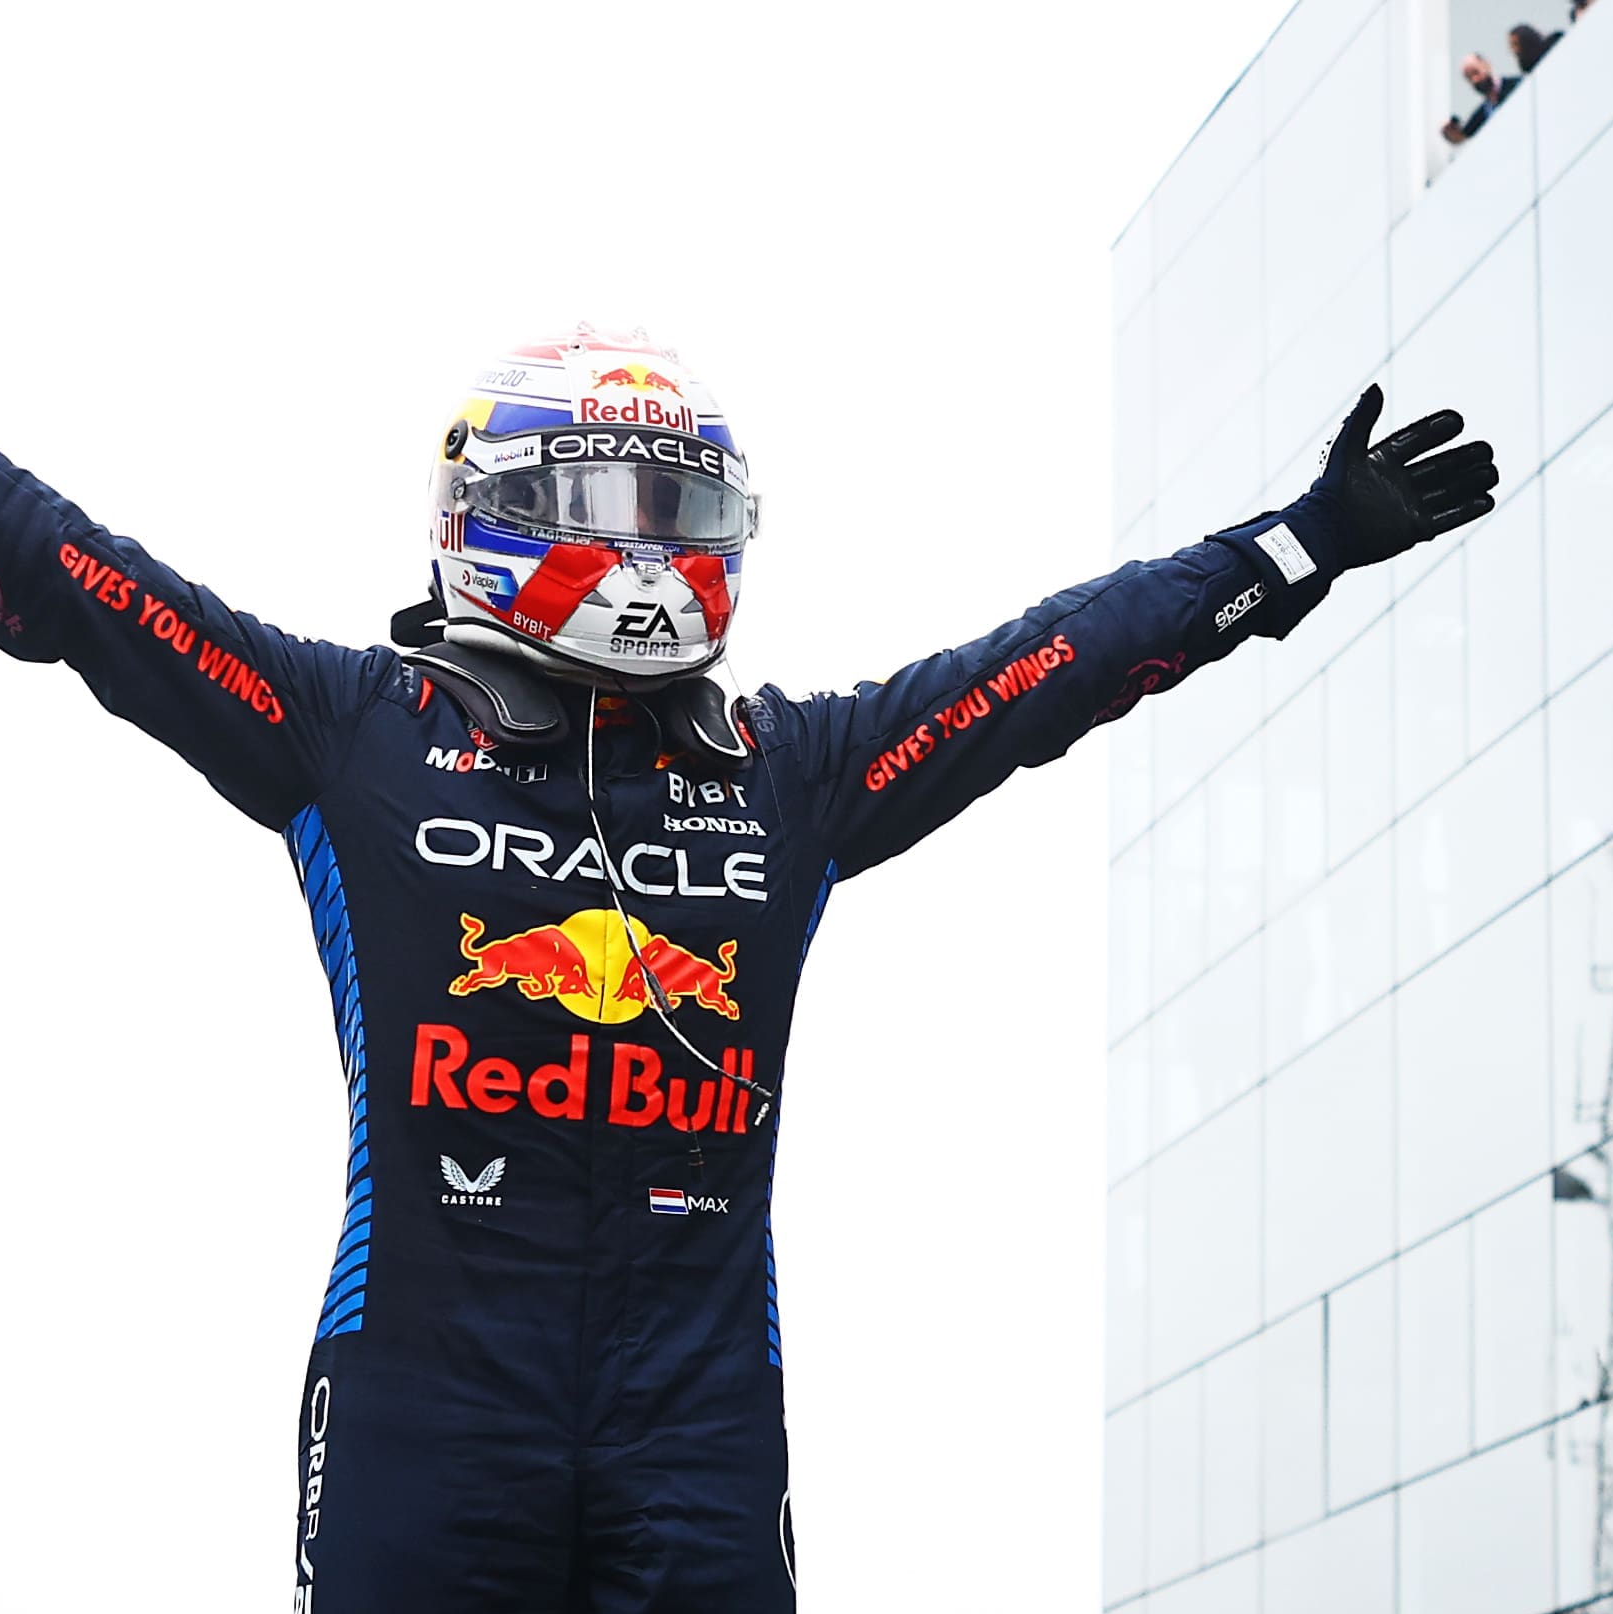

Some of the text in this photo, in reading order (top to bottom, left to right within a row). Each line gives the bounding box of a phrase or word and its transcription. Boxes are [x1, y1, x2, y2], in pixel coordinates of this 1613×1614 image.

[581, 397, 694, 434] Red Bull
[548, 433, 720, 475] ORACLE
[58, 543, 285, 725] GIVES YOU WINGS
[513, 611, 552, 642] BYBIT
[610, 602, 680, 640] EA
[609, 637, 680, 658] SPORTS
[865, 723, 936, 792] GIVES
[934, 687, 992, 740] YOU
[987, 633, 1076, 703] WINGS
[424, 746, 511, 777] Mob
[663, 813, 768, 837] HONDA
[414, 817, 769, 902] ORACLE
[410, 1023, 755, 1134] Red Bull
[441, 1194, 503, 1207] CASTORE
[688, 1195, 730, 1214] MAX
